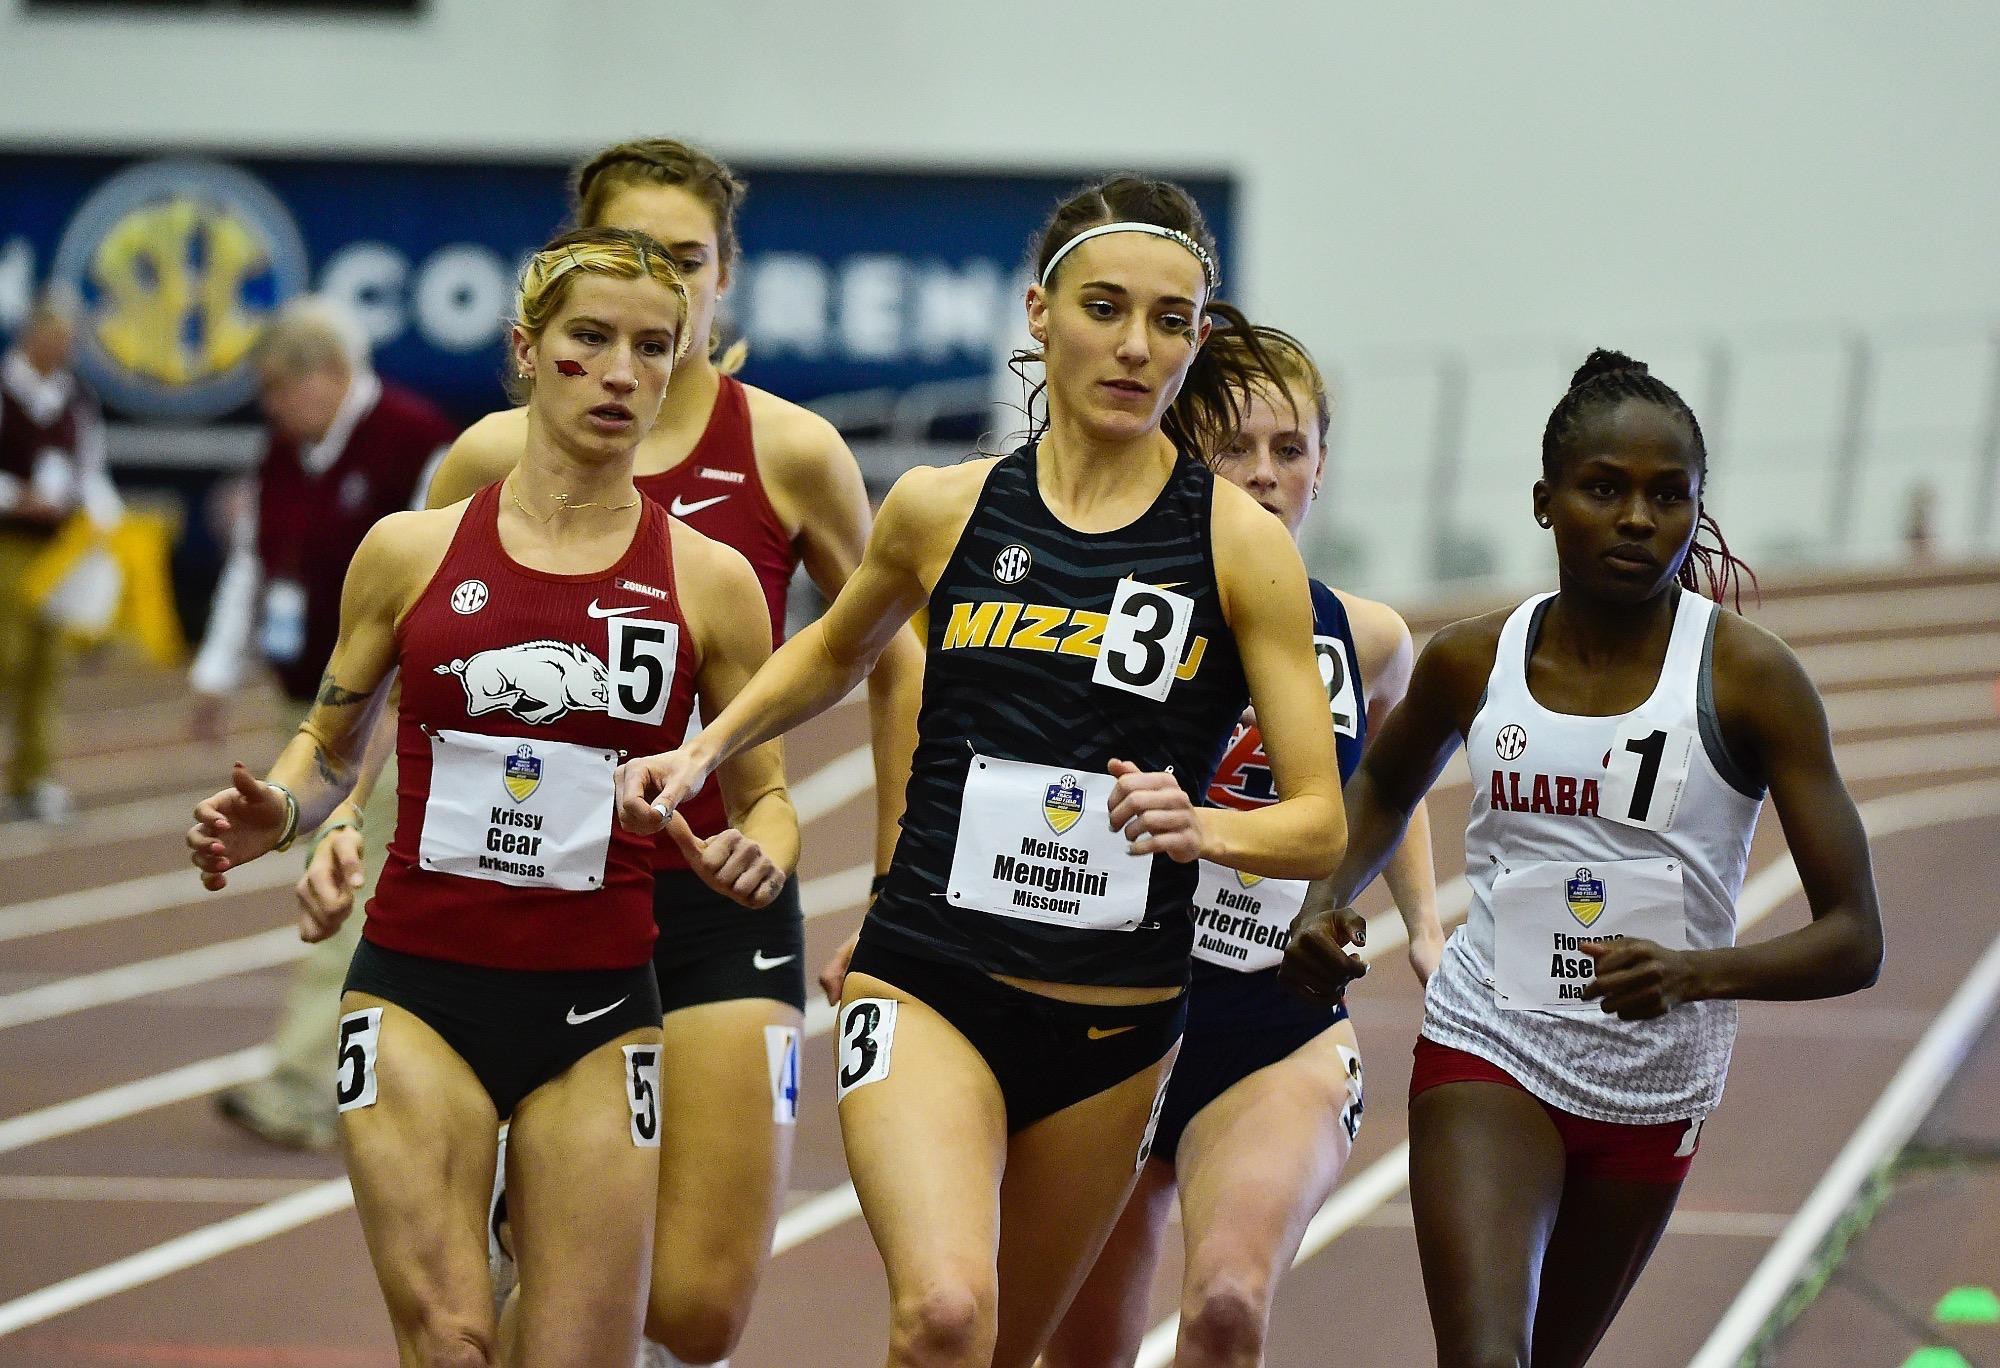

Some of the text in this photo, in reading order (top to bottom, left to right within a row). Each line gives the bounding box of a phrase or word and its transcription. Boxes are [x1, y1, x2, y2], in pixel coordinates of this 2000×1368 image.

[996, 548, 1029, 582] SEC
[454, 582, 485, 612] SEC
[622, 579, 668, 600] EQUALITY
[942, 602, 1209, 681] MIZZU
[1107, 592, 1174, 687] 3
[617, 624, 666, 715] 5
[1498, 725, 1526, 759] SEC
[1625, 729, 1667, 822] 1
[1490, 770, 1600, 817] ALABA
[490, 806, 544, 831] Krissy
[486, 827, 542, 857] Gear
[1020, 837, 1089, 865] Melissa
[478, 855, 545, 878] Arkansas
[992, 854, 1109, 897] Menghini
[1012, 889, 1081, 916] Missouri
[1216, 887, 1262, 915] Hallie
[1193, 904, 1291, 951] orterfield
[1198, 933, 1249, 961] Auburn
[1550, 953, 1594, 979] Ase
[336, 1016, 370, 1105] 5
[840, 1003, 880, 1089] 3
[632, 1051, 656, 1141] 5
